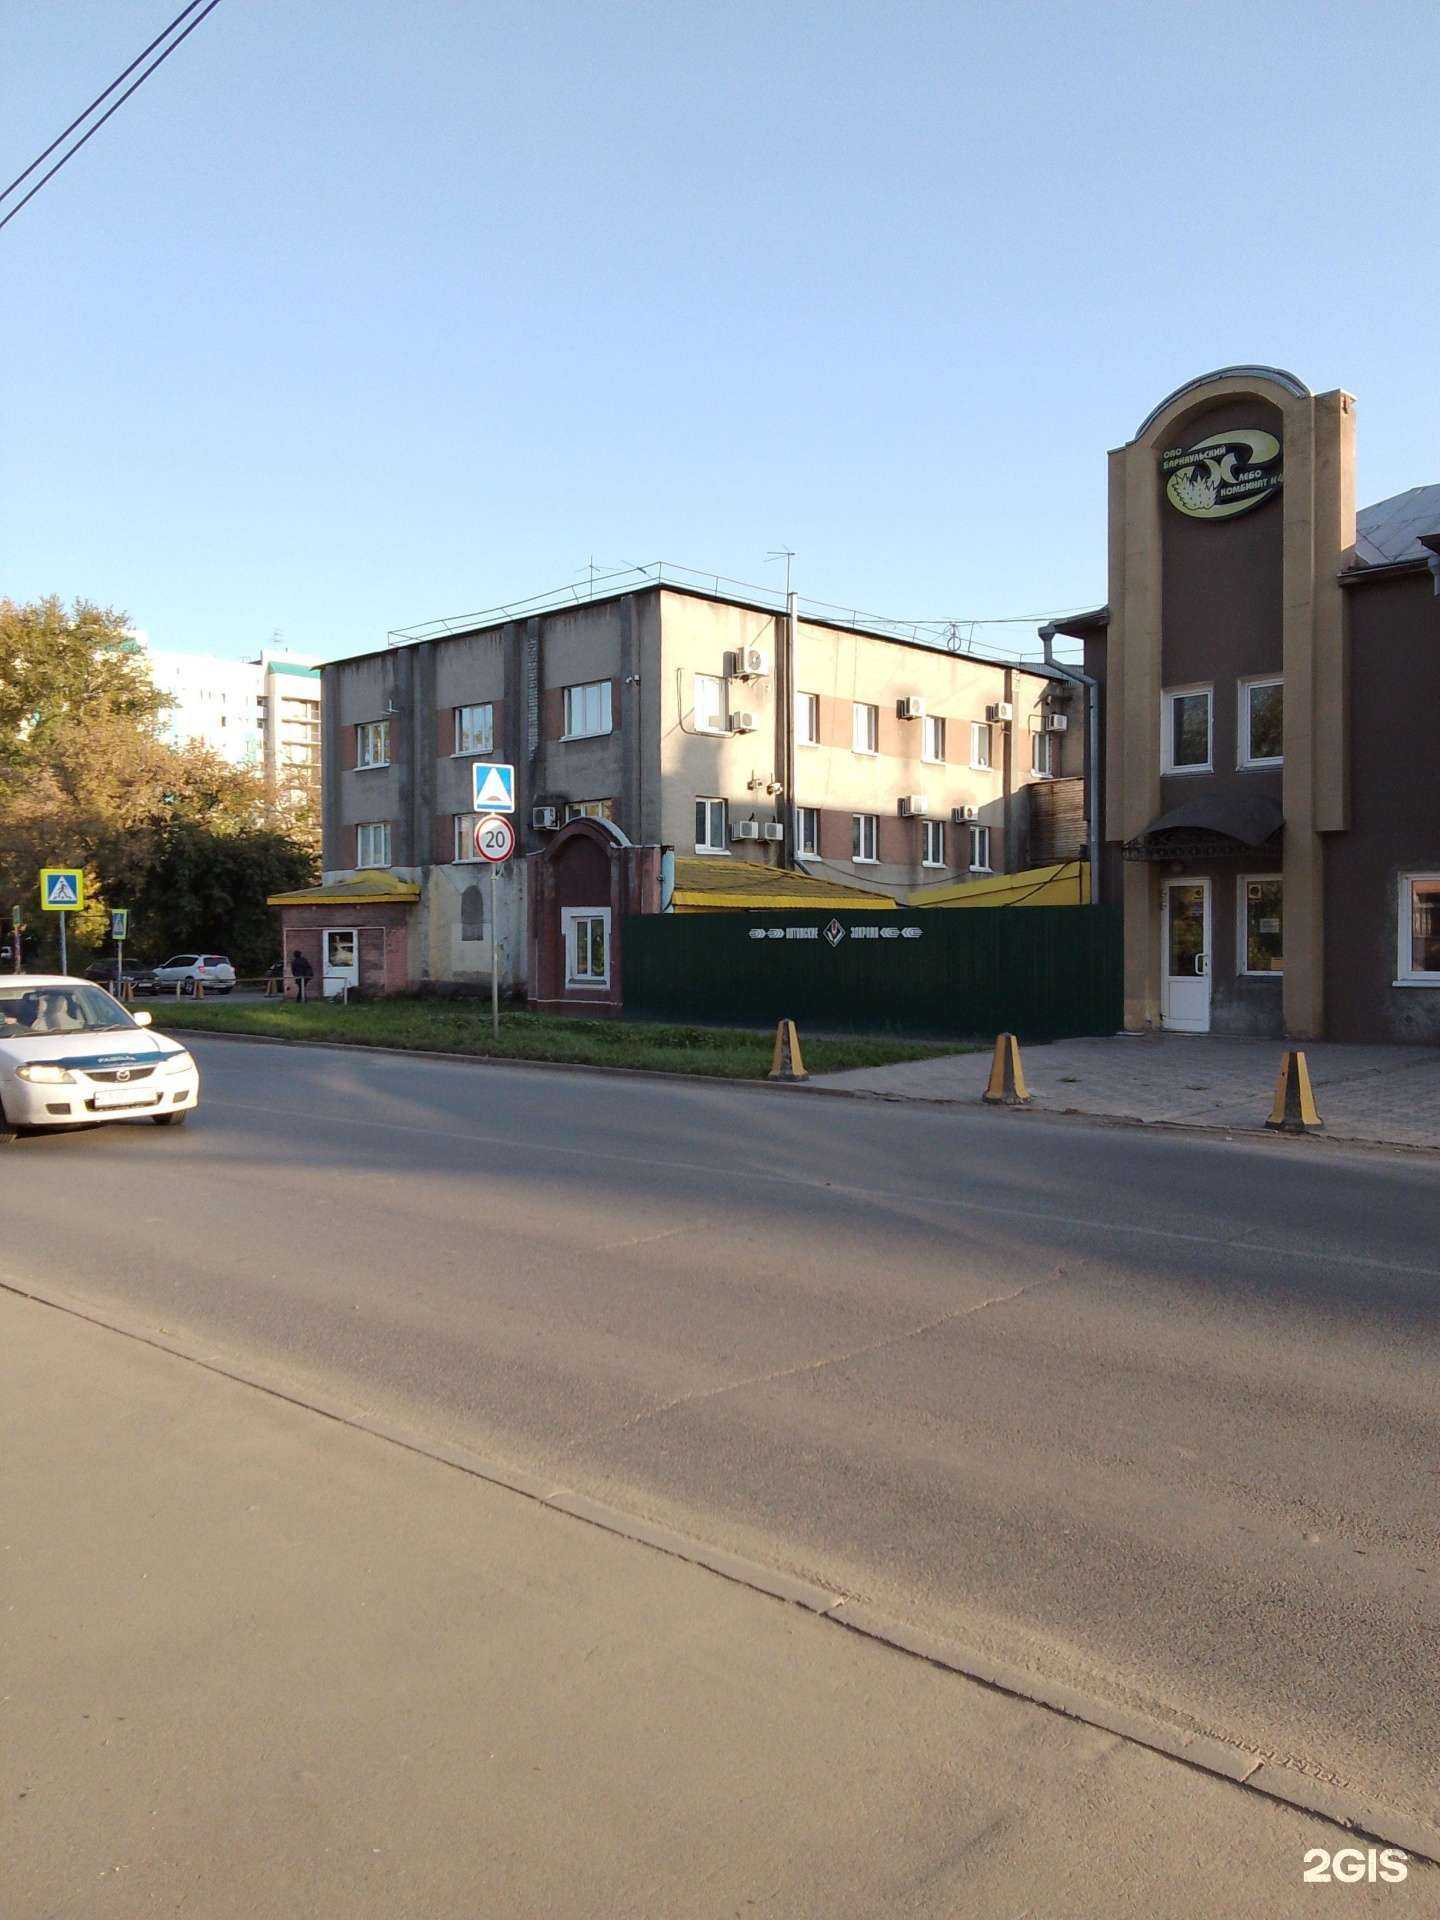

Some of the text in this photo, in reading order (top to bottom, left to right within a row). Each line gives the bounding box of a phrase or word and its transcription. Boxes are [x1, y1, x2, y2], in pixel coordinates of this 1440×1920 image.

[1163, 445, 1227, 469] БАРНАУЛЬСКИЙ
[1220, 478, 1268, 496] КОМБИНАТ
[486, 831, 505, 848] 20
